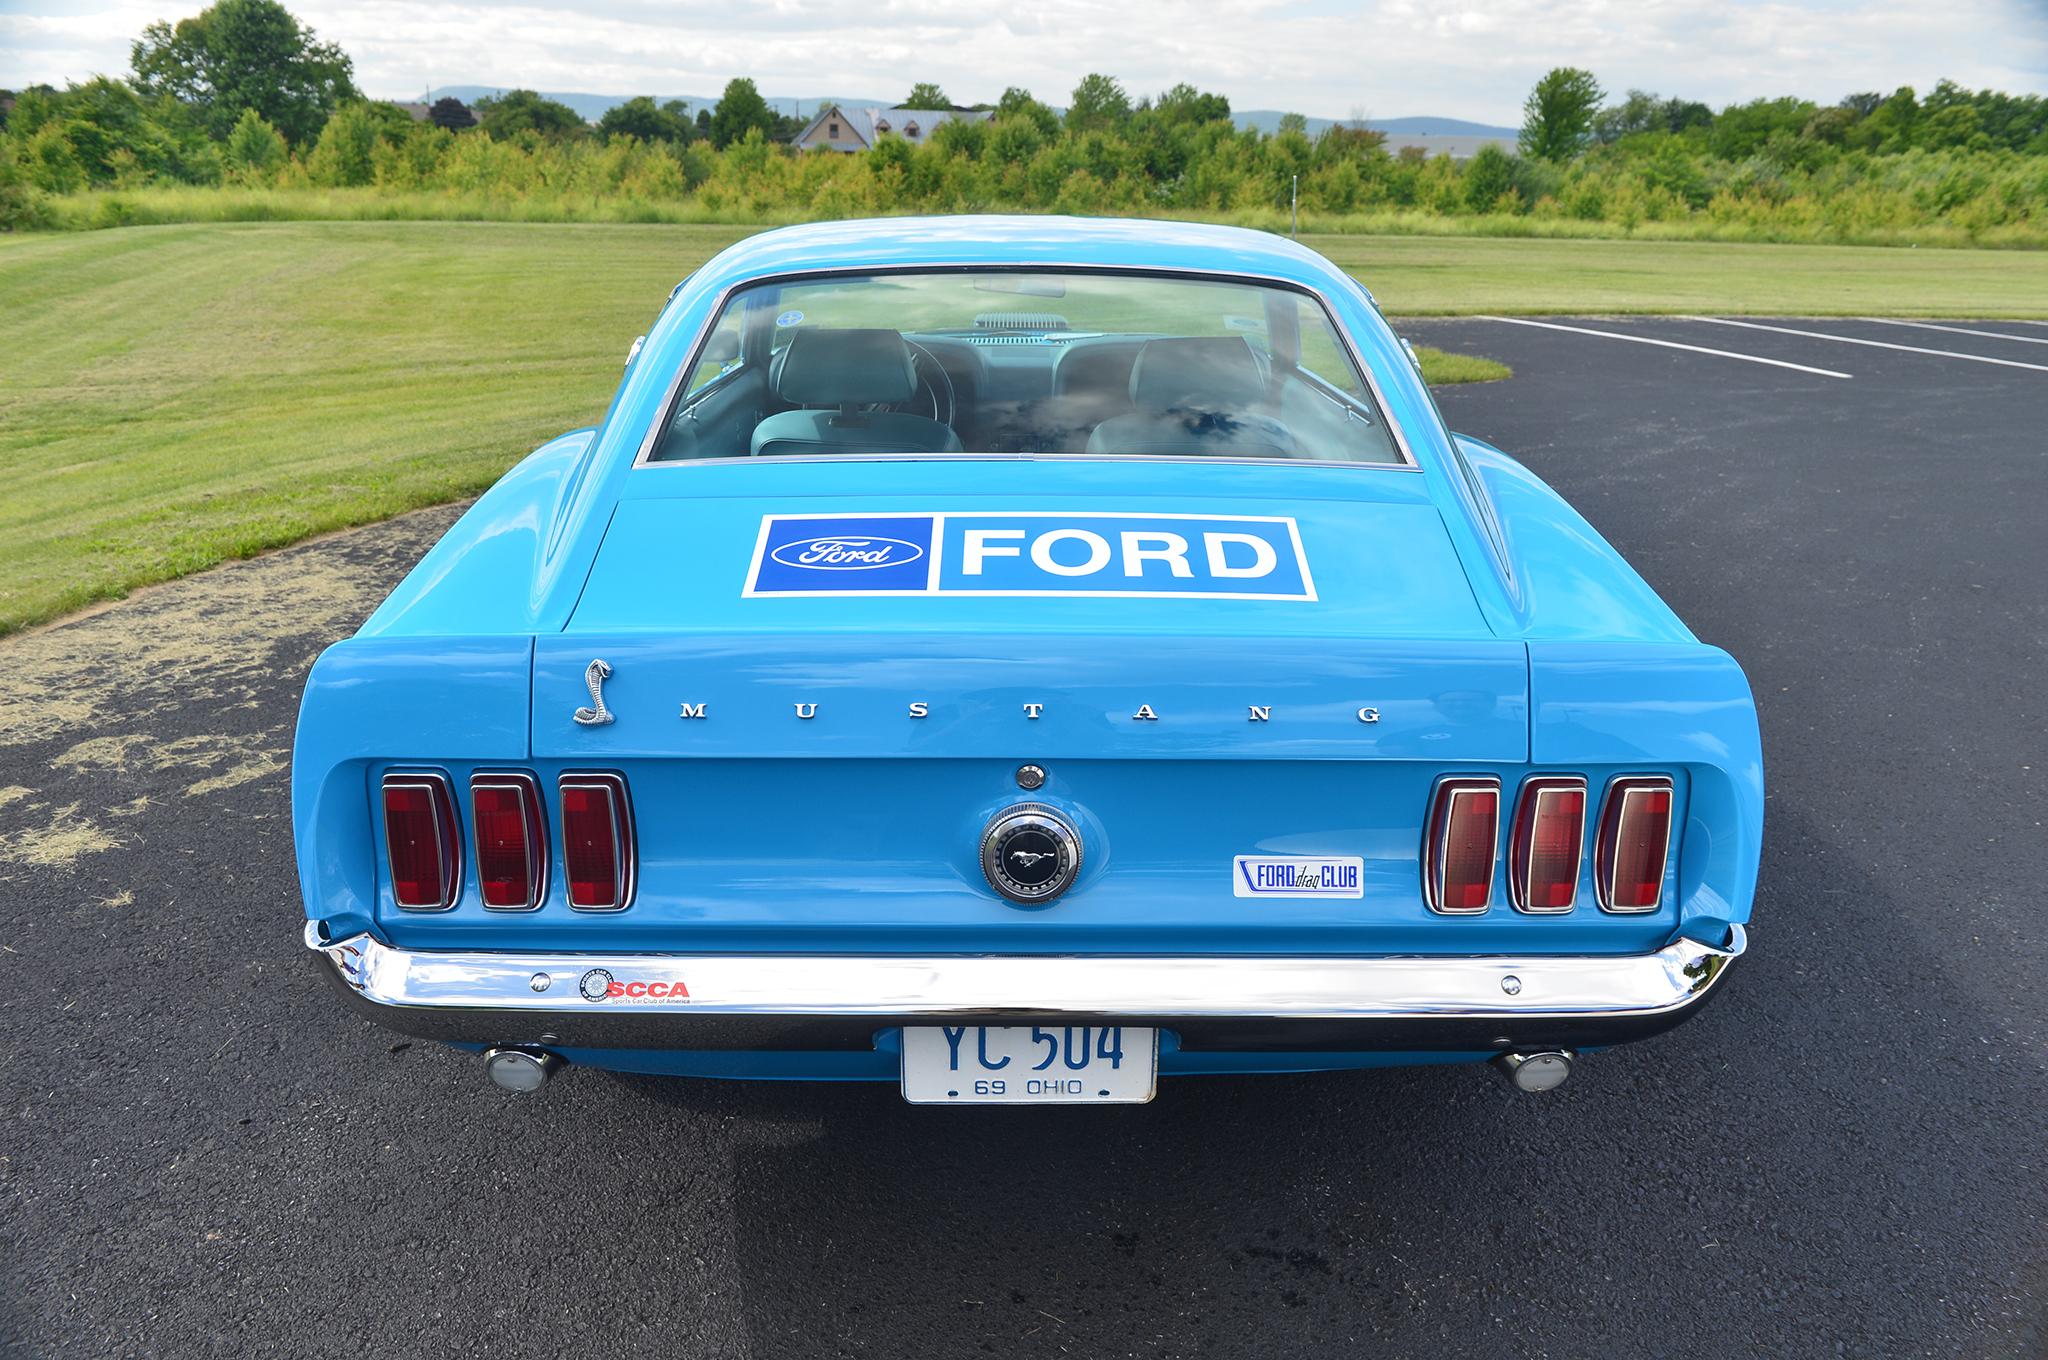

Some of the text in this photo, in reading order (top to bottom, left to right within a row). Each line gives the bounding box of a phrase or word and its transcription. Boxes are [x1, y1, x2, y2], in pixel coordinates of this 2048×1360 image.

[799, 540, 893, 563] Ford
[962, 528, 1277, 578] FORD
[679, 702, 1381, 724] MUSTANG
[1257, 864, 1358, 889] FORD drag CLUB
[605, 981, 690, 998] SCCA
[942, 1027, 1123, 1070] YC 504
[974, 1079, 1083, 1095] 69 OHIO
